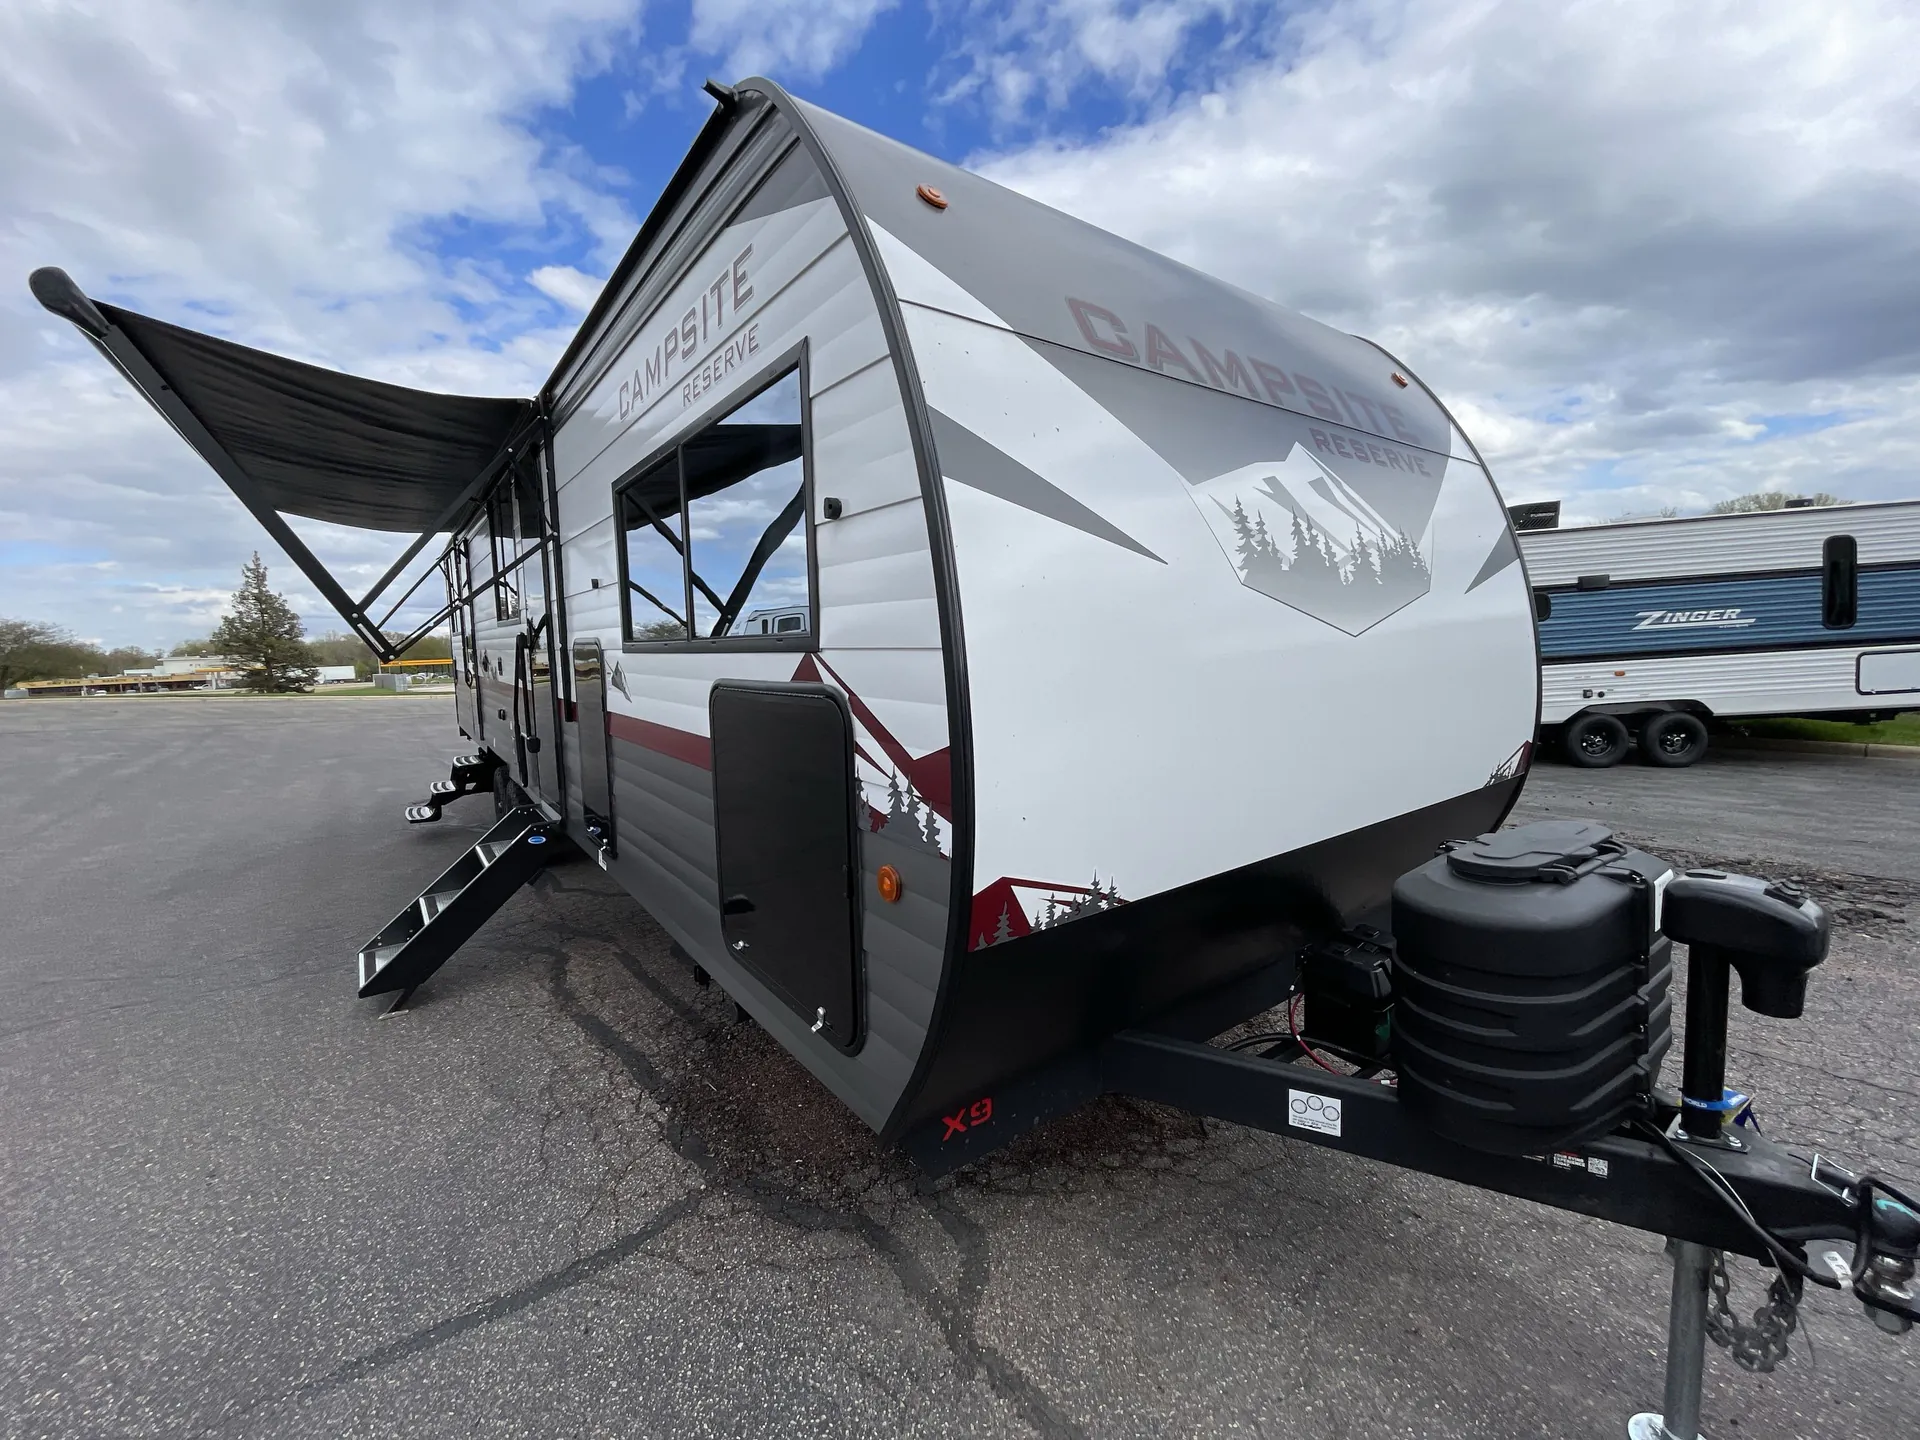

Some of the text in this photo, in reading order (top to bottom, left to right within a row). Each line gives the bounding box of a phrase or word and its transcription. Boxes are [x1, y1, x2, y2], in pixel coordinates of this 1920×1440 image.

[618, 243, 754, 421] CAMPSITE
[683, 323, 760, 407] RESERVE
[1065, 297, 1422, 446] CAMPSITE
[1309, 427, 1432, 477] RESERVE
[1632, 608, 1756, 630] ZINGER
